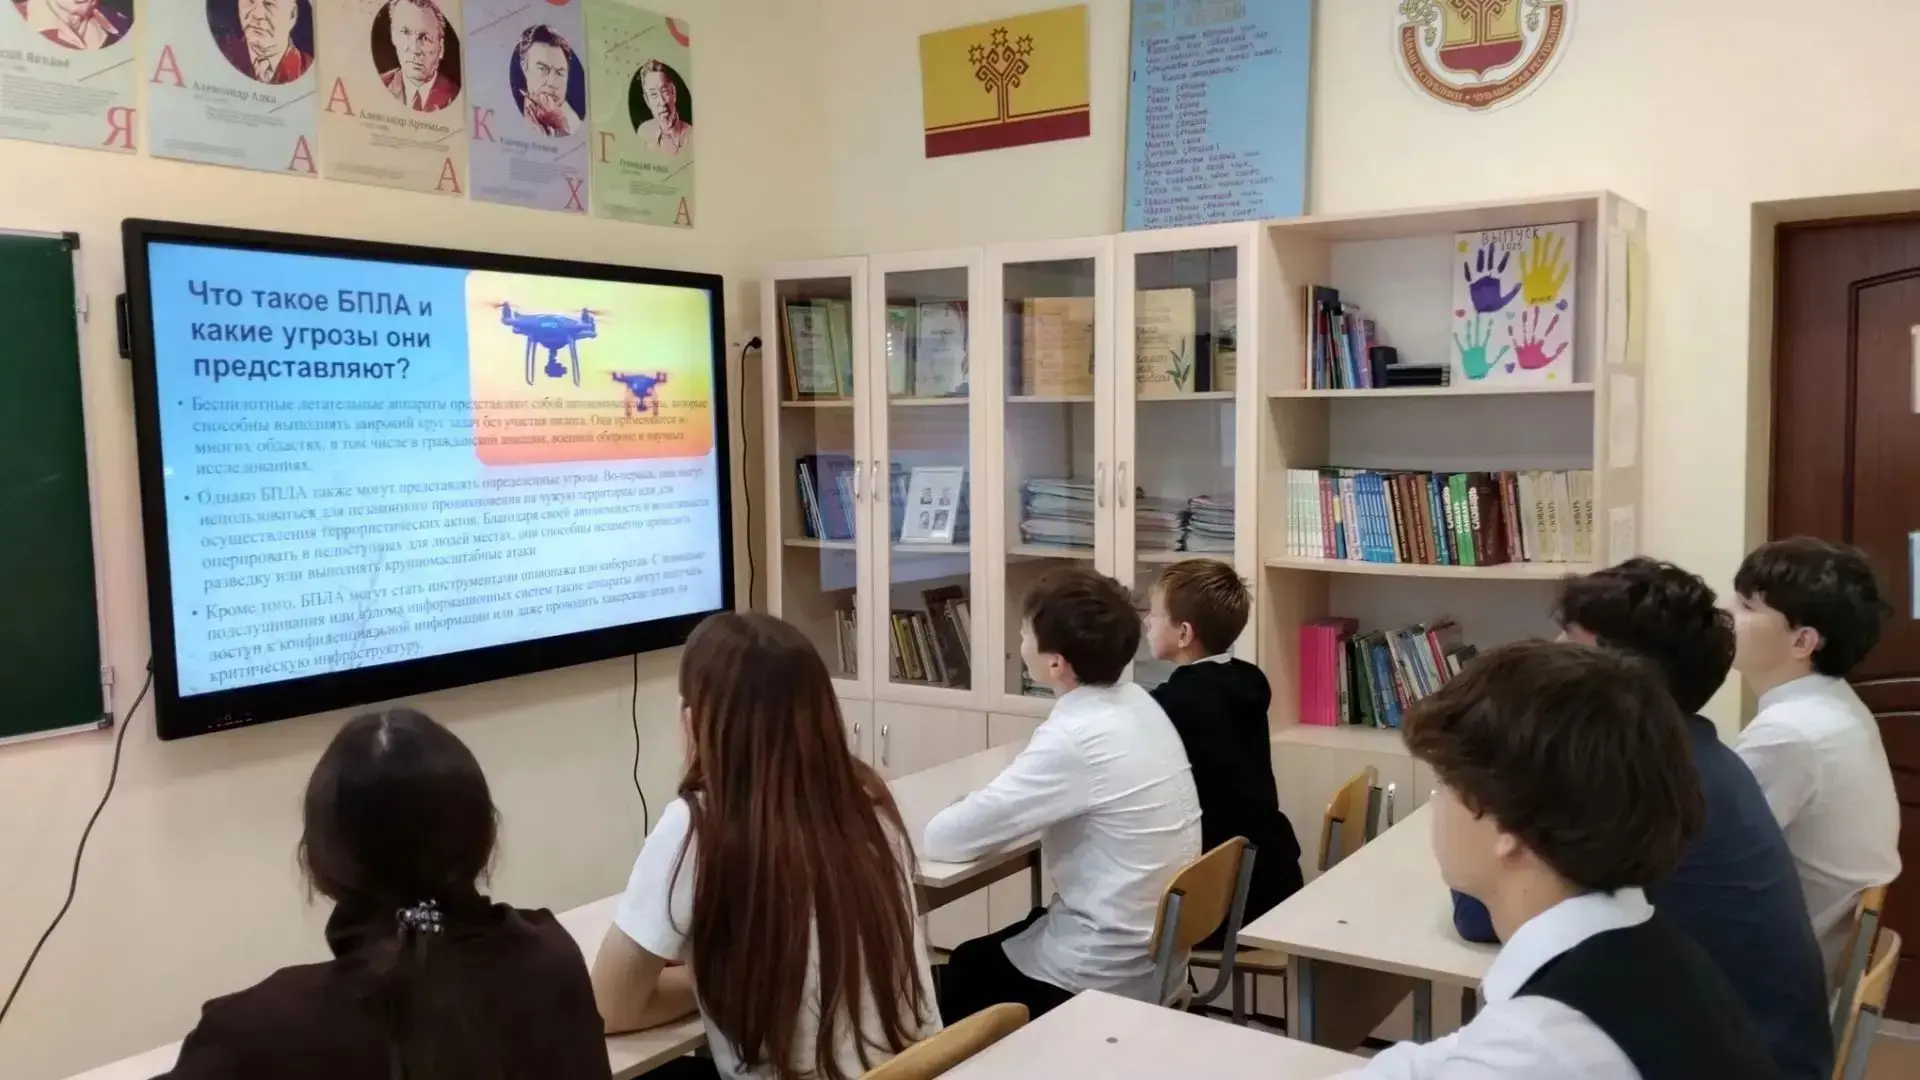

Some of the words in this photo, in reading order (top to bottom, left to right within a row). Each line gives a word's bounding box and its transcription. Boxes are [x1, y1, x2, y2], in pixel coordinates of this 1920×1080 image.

[151, 44, 187, 88] А
[324, 76, 356, 116] А
[103, 106, 136, 149] Я
[471, 105, 496, 142] К
[288, 135, 318, 173] А
[599, 131, 616, 163] Г
[434, 157, 461, 193] А
[564, 177, 585, 211] Х
[674, 196, 693, 226] А
[1482, 228, 1539, 245] ВЫПУСК
[188, 279, 243, 306] Что
[252, 289, 329, 312] такое
[338, 289, 412, 317] БПЛА
[419, 300, 432, 318] и
[191, 321, 273, 343] какие
[282, 326, 378, 350] угрозы
[386, 331, 431, 349] они
[194, 357, 410, 383] представляют?
[191, 418, 268, 432] способны
[193, 443, 251, 453] многих
[197, 489, 255, 505] Однако
[260, 484, 307, 500] БПЛА
[312, 485, 351, 498] также
[356, 483, 395, 497] могут
[1469, 486, 1480, 530] словарь
[1453, 501, 1463, 534] СЛОВАРЬ
[1461, 500, 1470, 533] СЛОВАРЬ
[200, 528, 316, 549] осуществления
[321, 519, 439, 539] террористических
[201, 550, 297, 569] оперировать
[203, 573, 271, 593] разведку
[275, 570, 302, 582] или
[307, 562, 380, 578] выполнять
[205, 603, 255, 622] Кроме
[300, 589, 344, 608] БПЛА
[349, 588, 388, 602] могут
[391, 583, 424, 597] стать
[207, 615, 324, 640] подслушивания
[329, 611, 354, 624] или
[208, 643, 261, 662] доступ
[266, 641, 276, 652] к
[209, 656, 309, 684] критическую
